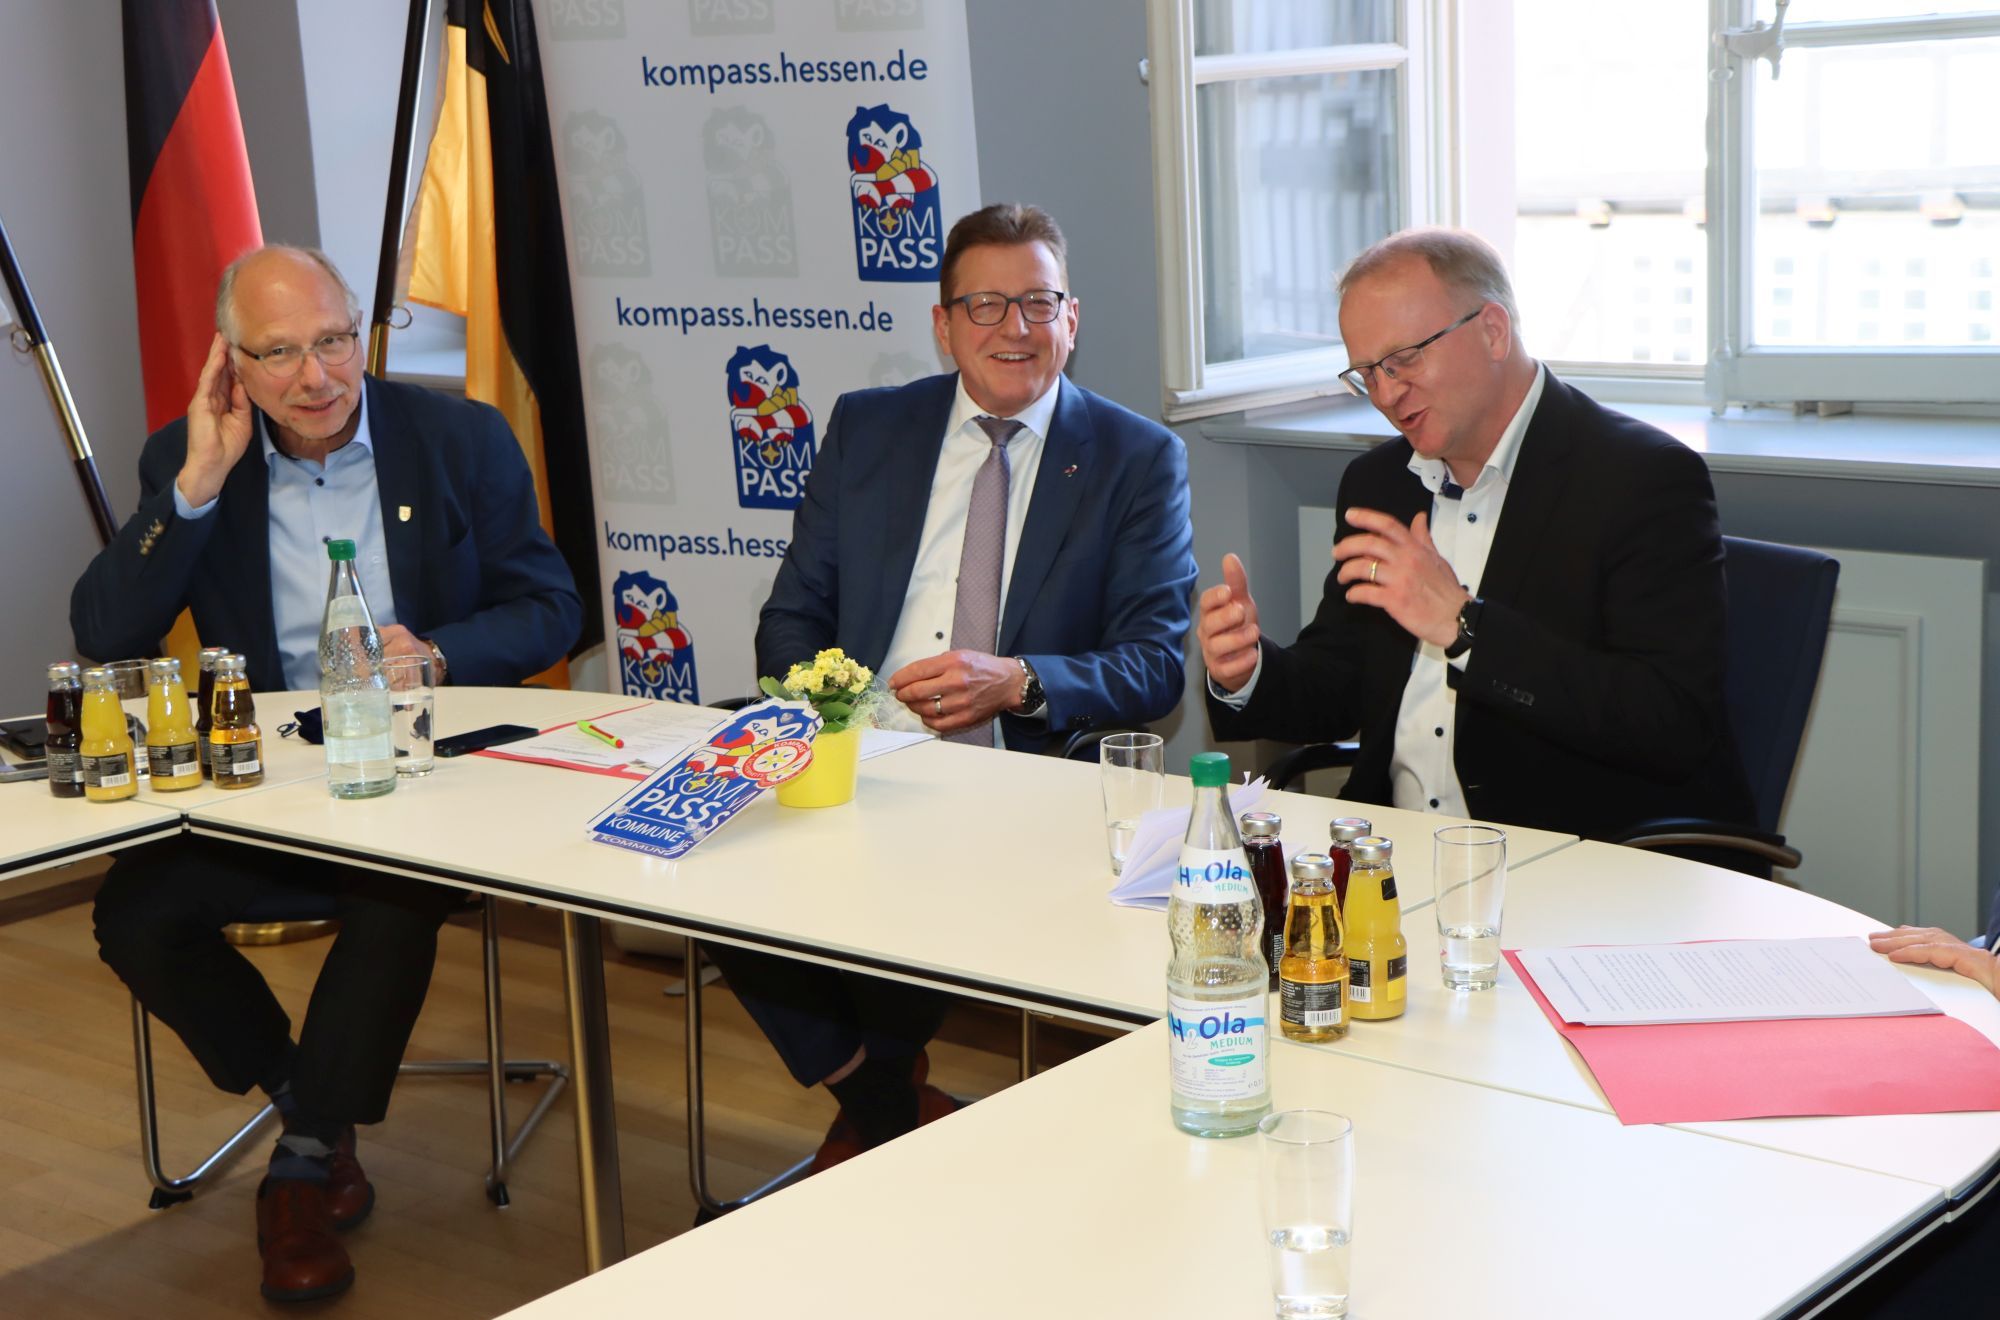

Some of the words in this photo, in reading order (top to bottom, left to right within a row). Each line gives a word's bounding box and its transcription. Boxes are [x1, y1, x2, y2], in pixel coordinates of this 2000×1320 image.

[642, 49, 928, 94] kompass.hessen.de
[858, 205, 935, 238] KOM
[577, 236, 646, 265] PASS
[718, 236, 793, 265] PASS
[861, 237, 939, 269] PASS
[616, 297, 894, 335] kompass.hessen.de
[739, 438, 812, 470] KOM
[603, 464, 670, 494] PASS
[605, 520, 787, 561] kompass.hess
[624, 656, 693, 689] KOM
[656, 767, 750, 803] KOM
[630, 788, 723, 823] PASS
[606, 816, 685, 843] KOMMUNE
[1215, 883, 1248, 894] MEDIUM
[1210, 1037, 1253, 1050] MEDIUM
